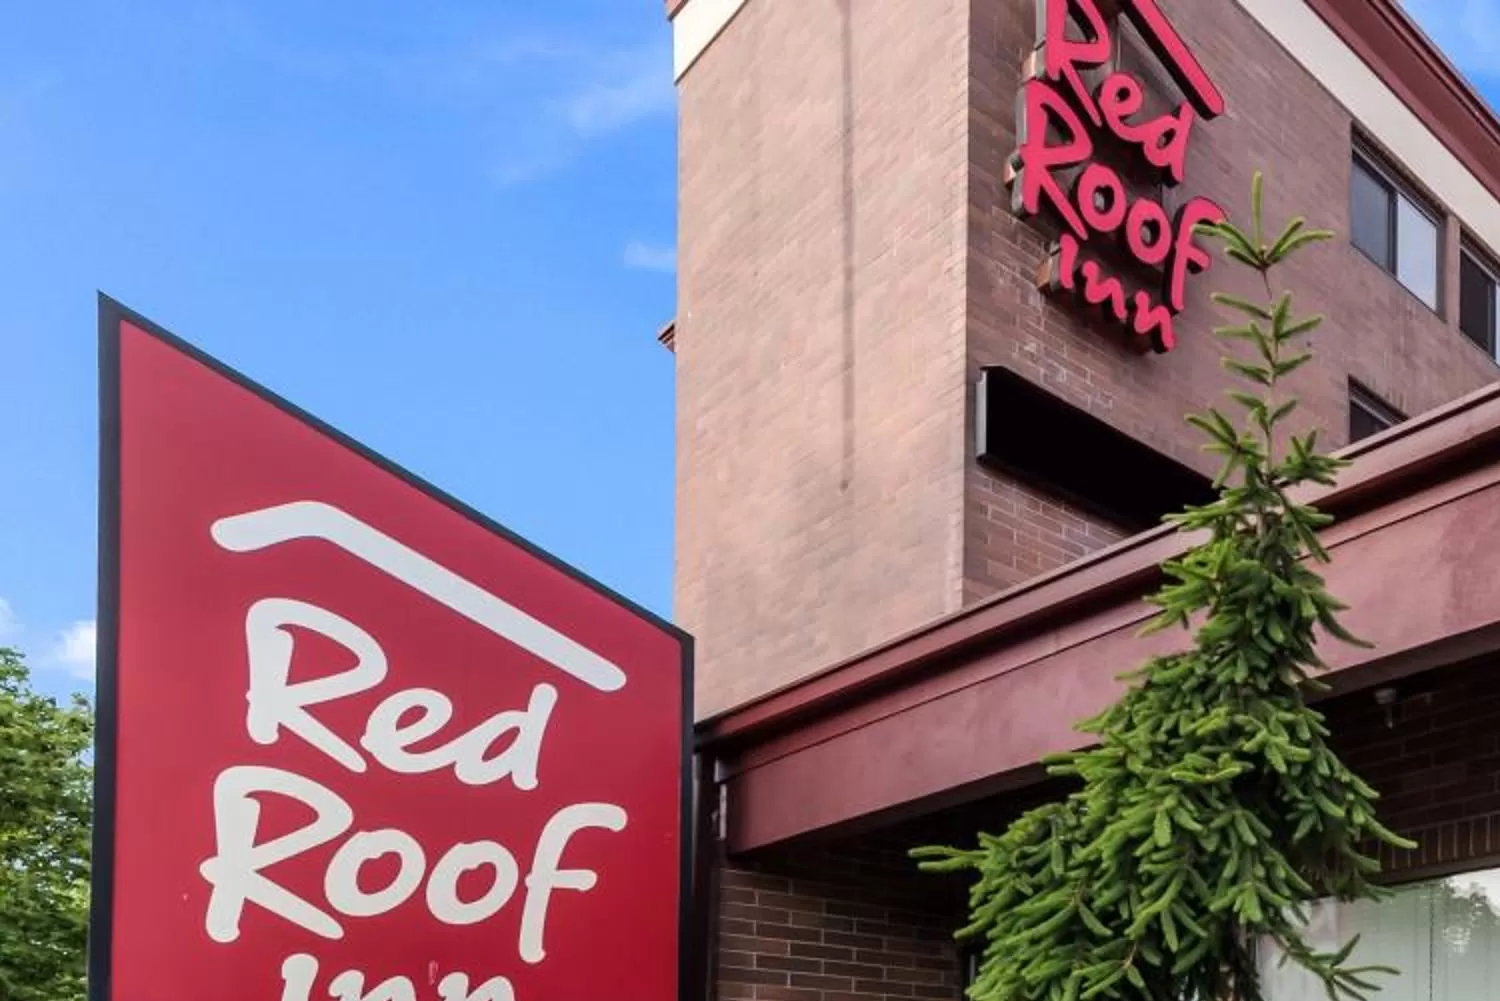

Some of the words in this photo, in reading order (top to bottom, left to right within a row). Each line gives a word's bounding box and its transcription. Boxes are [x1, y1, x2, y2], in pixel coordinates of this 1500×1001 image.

[1044, 0, 1194, 182] Red
[1019, 78, 1228, 311] Roof
[1058, 232, 1176, 351] Inn
[244, 597, 559, 791] Red
[199, 765, 628, 964] Roof
